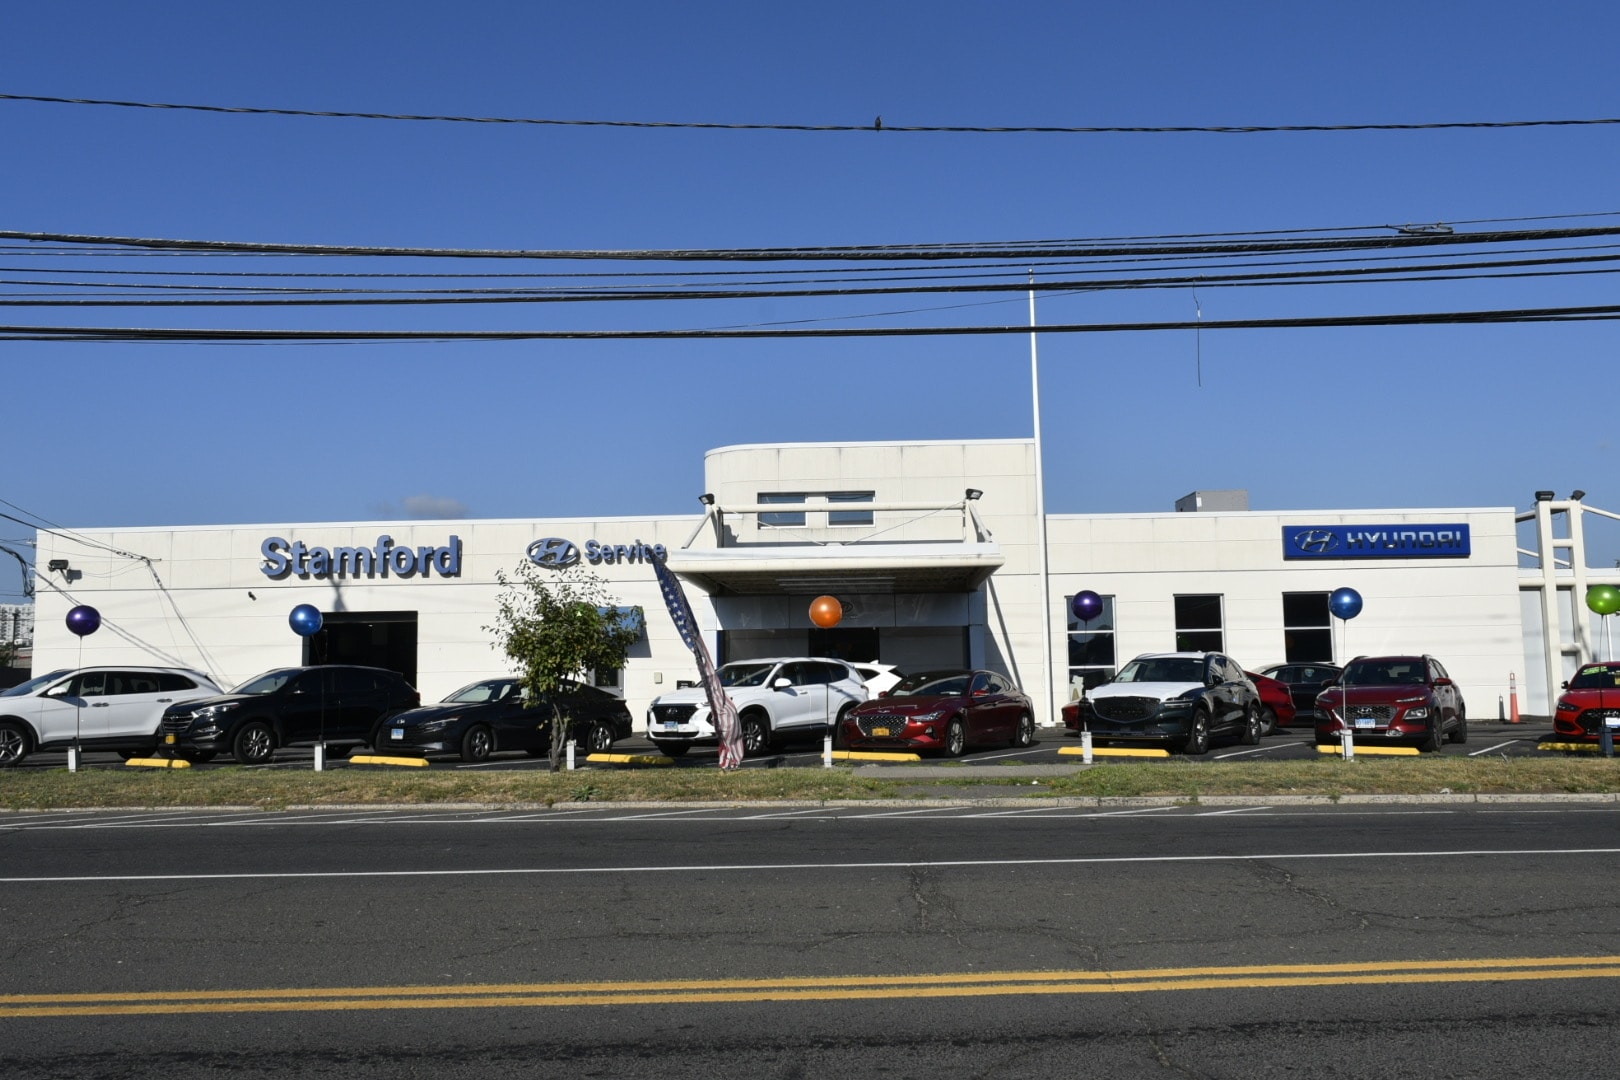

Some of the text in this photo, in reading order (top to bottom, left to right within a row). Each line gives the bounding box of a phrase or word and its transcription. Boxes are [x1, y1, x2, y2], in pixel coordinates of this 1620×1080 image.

[584, 538, 666, 561] Service
[1347, 531, 1461, 549] HYUNDAI
[260, 534, 459, 576] Stamford
